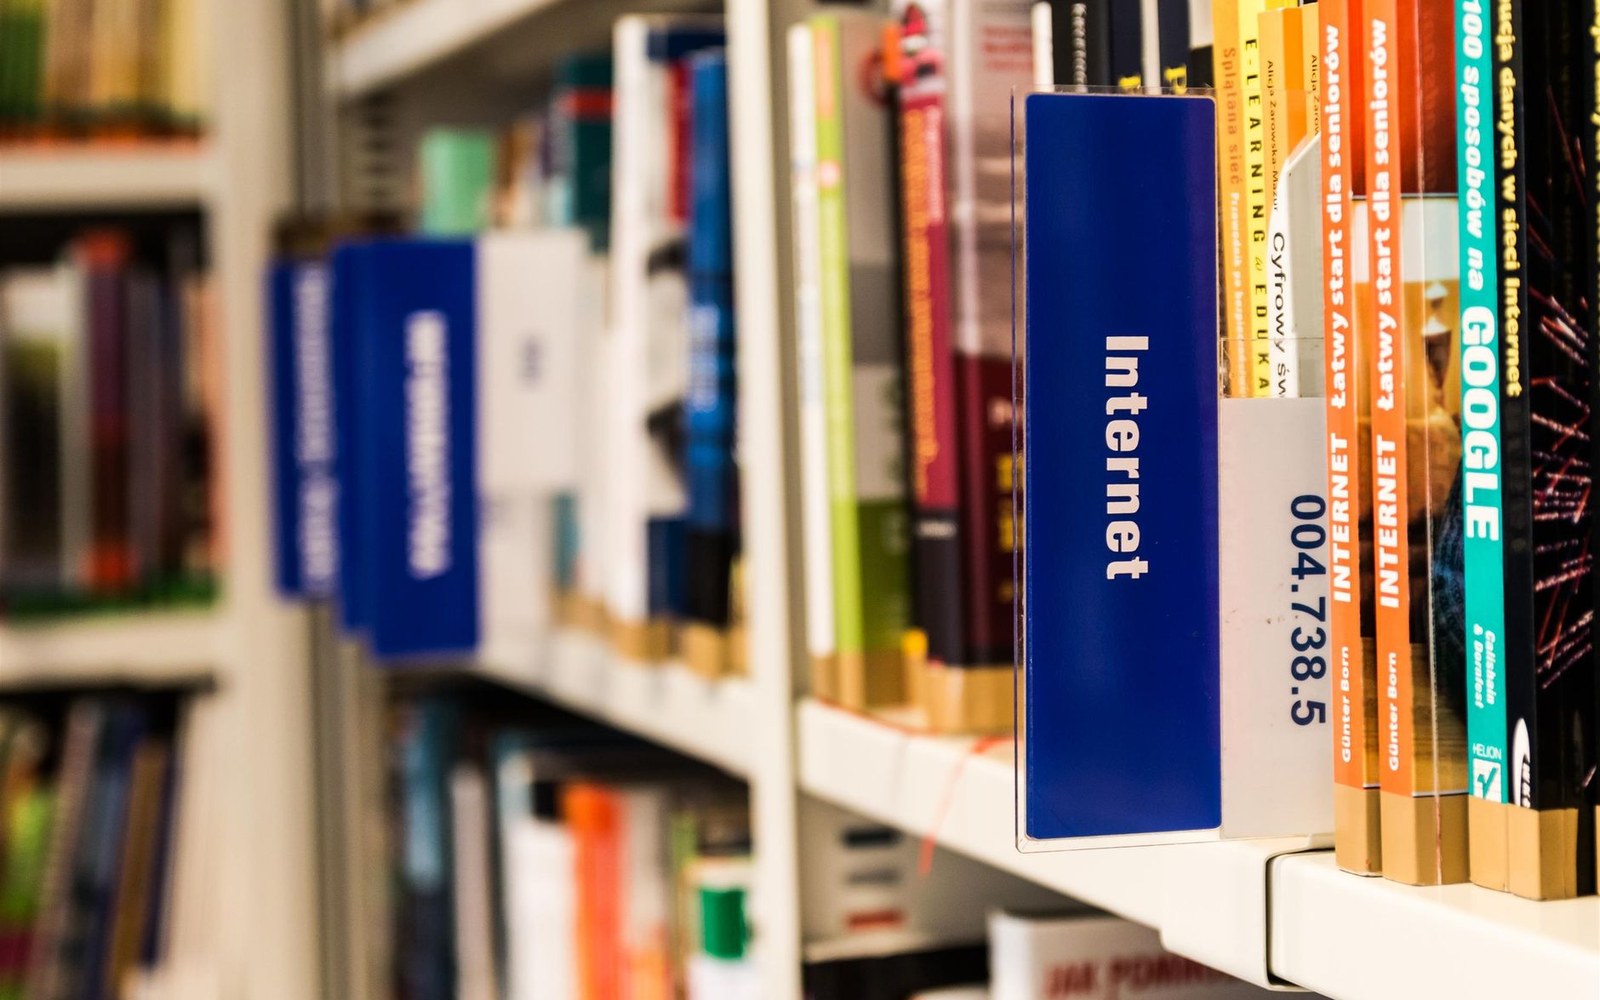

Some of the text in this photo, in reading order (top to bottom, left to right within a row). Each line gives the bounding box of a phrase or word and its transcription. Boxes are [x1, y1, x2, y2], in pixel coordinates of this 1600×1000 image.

[1221, 47, 1243, 185] Splątana sieć
[1266, 60, 1275, 97] Alicja
[1324, 24, 1342, 168] seniorów
[1369, 18, 1390, 166] seniorów
[1245, 38, 1265, 243] E-LEARNING
[1255, 284, 1271, 391] EDUKA
[1326, 173, 1343, 223] dla
[1372, 171, 1390, 223] dla
[1461, 65, 1486, 238] sposobów
[1495, 0, 1522, 398] ucja danych w sieci Internet
[1271, 232, 1287, 353] Cyfrowy
[1329, 229, 1345, 306] start
[1375, 227, 1393, 306] start
[1467, 247, 1484, 291] na
[1105, 336, 1150, 580] Internet
[1462, 306, 1500, 541] GOOGLE
[1330, 433, 1351, 603] INTERNET
[1377, 434, 1399, 608] INTERNET
[1290, 494, 1327, 726] 004.738.5
[1340, 646, 1351, 763] Günter Born
[1387, 652, 1399, 771] Günter Born
[1473, 743, 1502, 760] HELION
